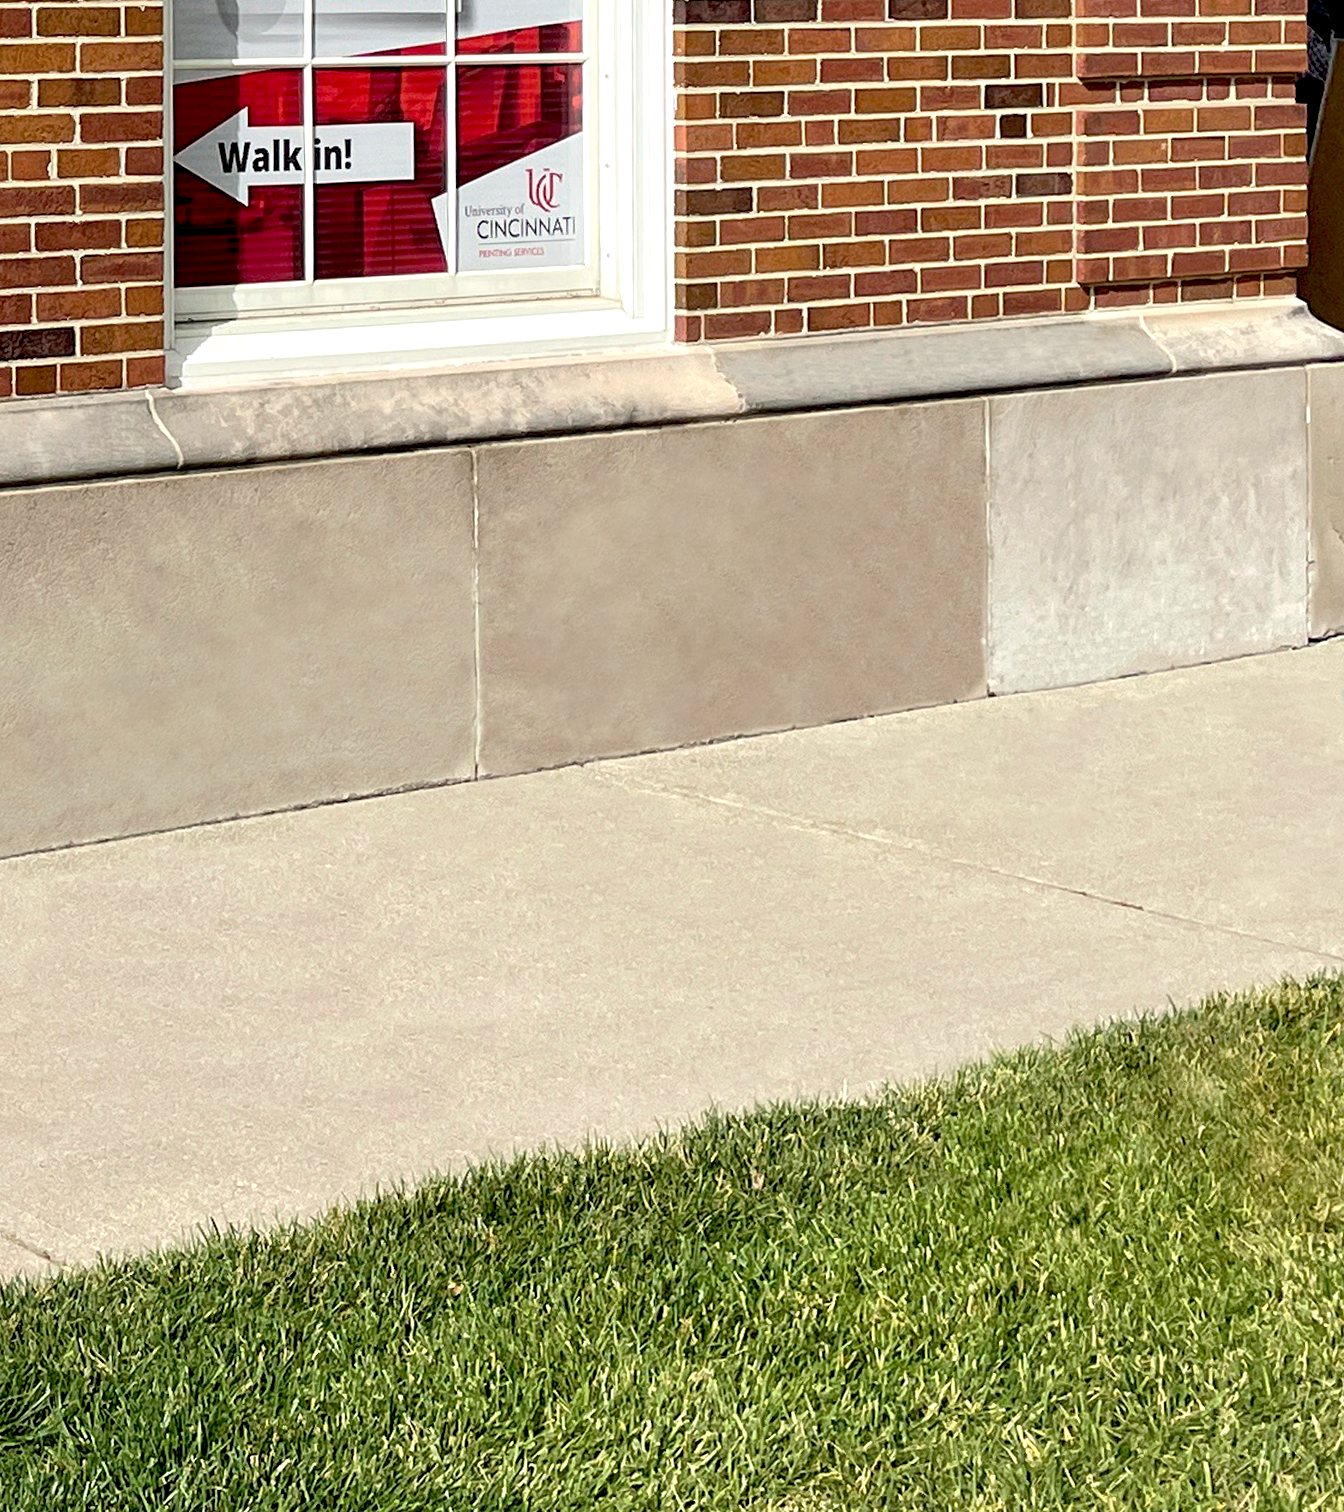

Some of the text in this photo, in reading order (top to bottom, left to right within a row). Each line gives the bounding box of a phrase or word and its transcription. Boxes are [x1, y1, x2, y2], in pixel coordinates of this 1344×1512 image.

[218, 138, 352, 173] Walk in!
[465, 203, 525, 217] University of
[477, 216, 576, 239] CINCINNATI
